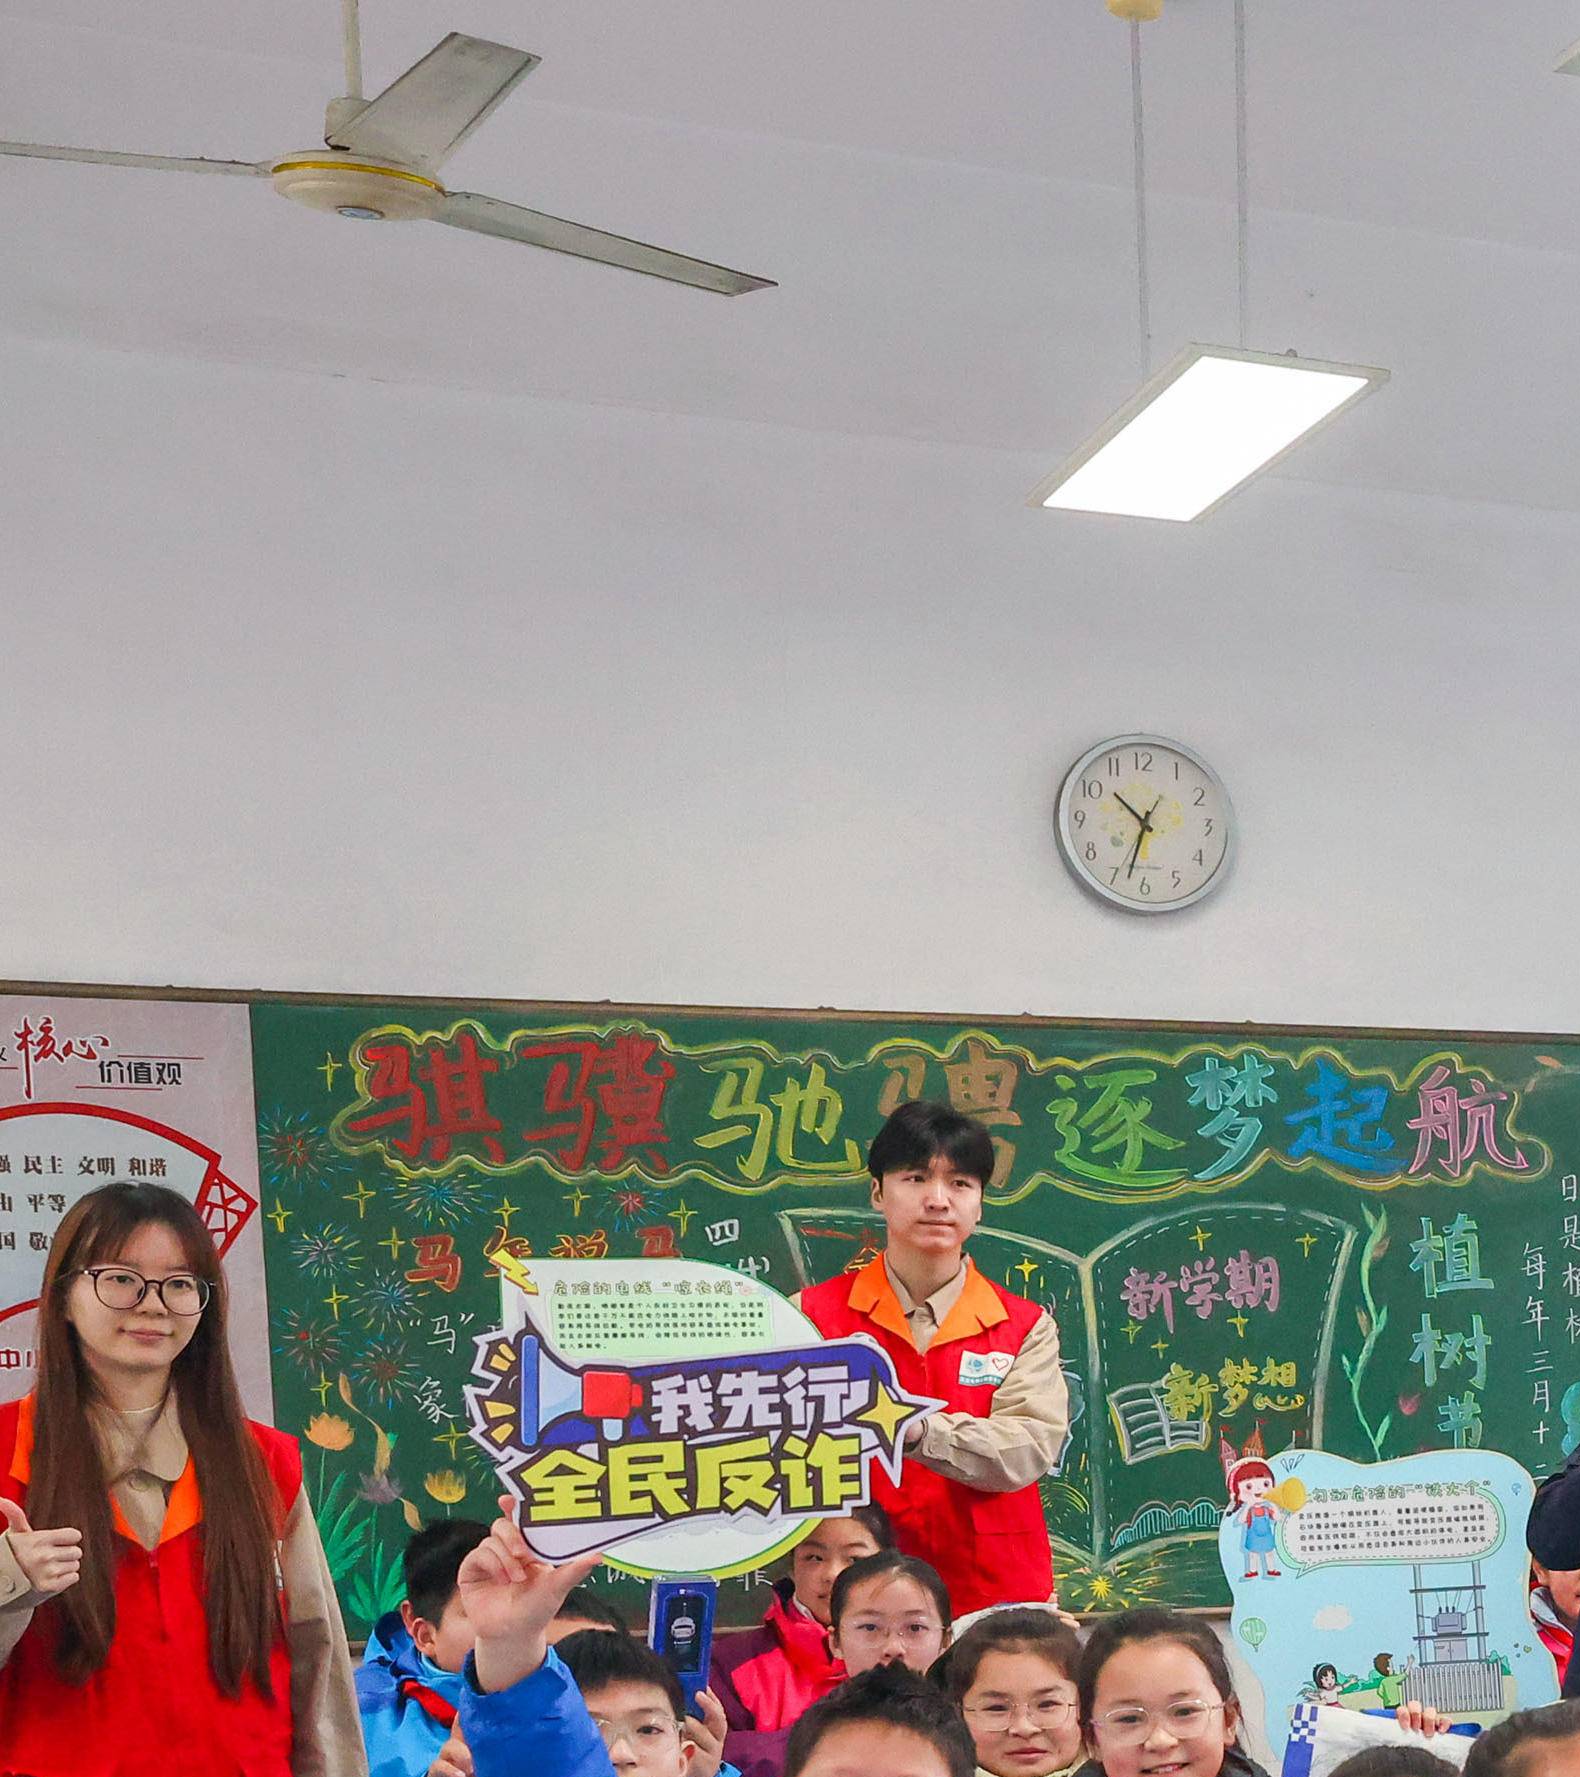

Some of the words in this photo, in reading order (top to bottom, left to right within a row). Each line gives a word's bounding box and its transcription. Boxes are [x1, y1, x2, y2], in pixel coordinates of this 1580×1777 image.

[1108, 757, 1120, 777] 11
[1134, 751, 1153, 772] 12
[1082, 779, 1103, 800] 10
[1193, 786, 1206, 807] 2
[1074, 810, 1086, 829] 9
[1204, 818, 1213, 837] 3
[1085, 841, 1097, 861] 8
[1192, 848, 1203, 866] 4
[1105, 866, 1120, 886] 7
[1139, 876, 1150, 896] 6
[1171, 870, 1181, 889] 5
[13, 1015, 110, 1099] 核心
[99, 1060, 182, 1086] 价值观
[23, 1155, 64, 1175] 民主
[77, 1155, 116, 1177] 文明
[128, 1156, 168, 1178] 和谐
[27, 1193, 66, 1213] 平等
[1119, 1247, 1281, 1336] 新学期
[1408, 1211, 1496, 1449] 植树节
[651, 1364, 870, 1435] 我先行
[519, 1434, 864, 1523] 全民反诈
